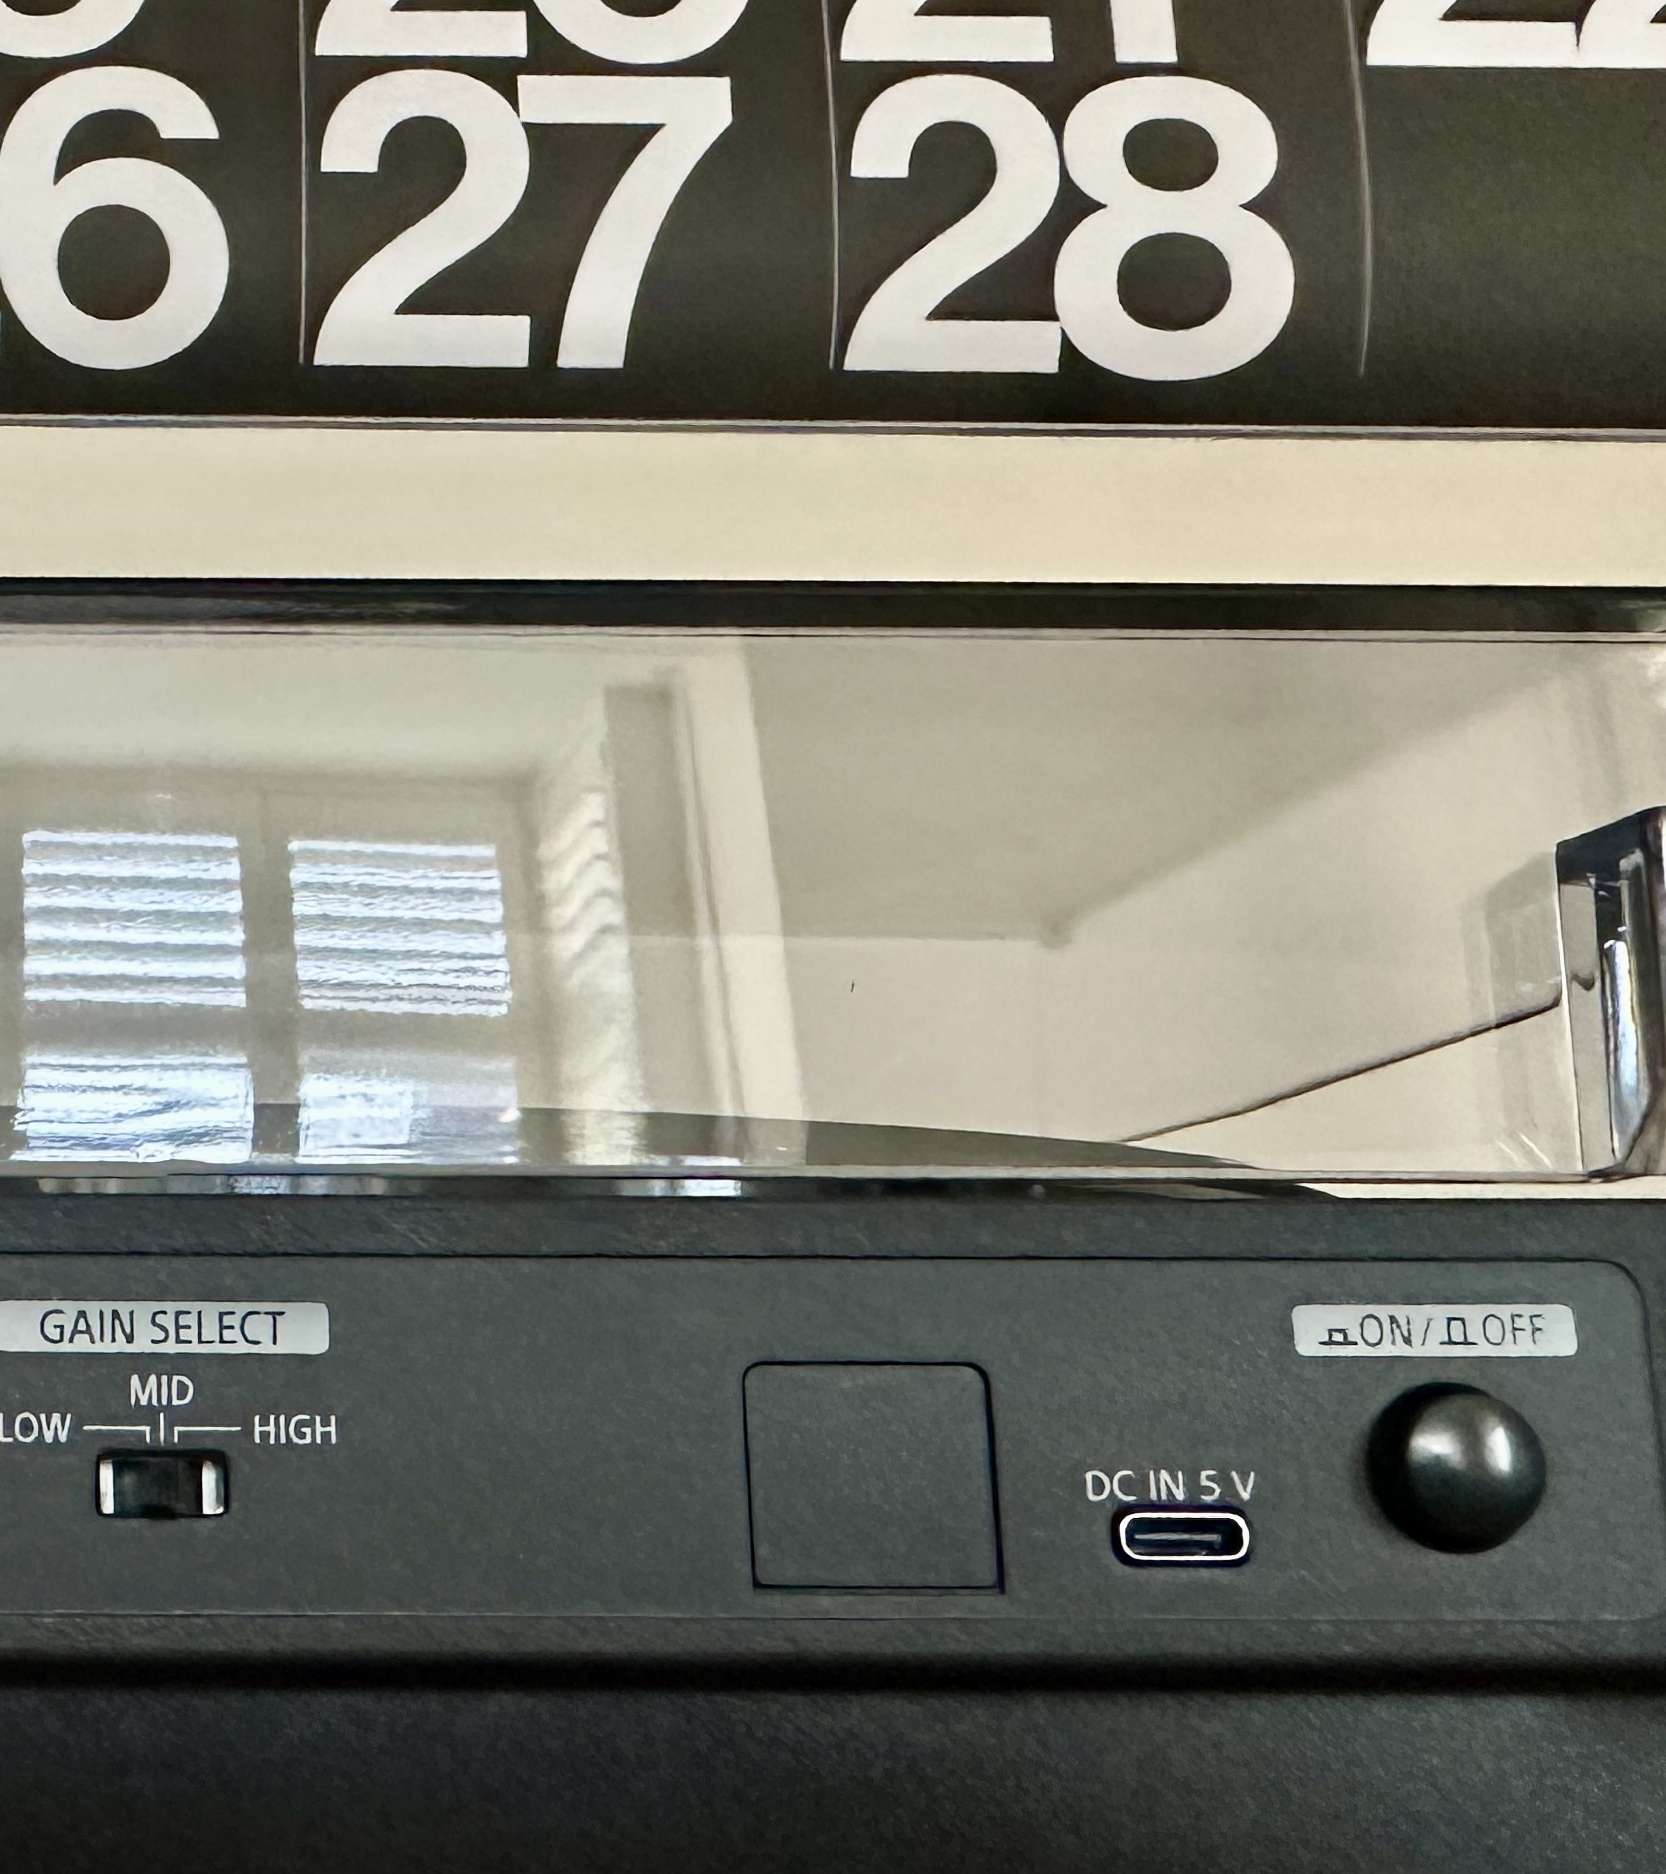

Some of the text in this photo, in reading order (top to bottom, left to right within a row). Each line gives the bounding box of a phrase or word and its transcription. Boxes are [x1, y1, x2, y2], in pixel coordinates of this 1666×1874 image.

[314, 69, 732, 368] 27
[843, 74, 1294, 380] 28
[40, 1309, 286, 1346] GAIN SELECT
[1482, 1313, 1546, 1347] OFF
[130, 1373, 194, 1407] MID
[253, 1414, 337, 1446] HIGH
[1085, 1470, 1137, 1502] DC
[1149, 1469, 1185, 1501] IN
